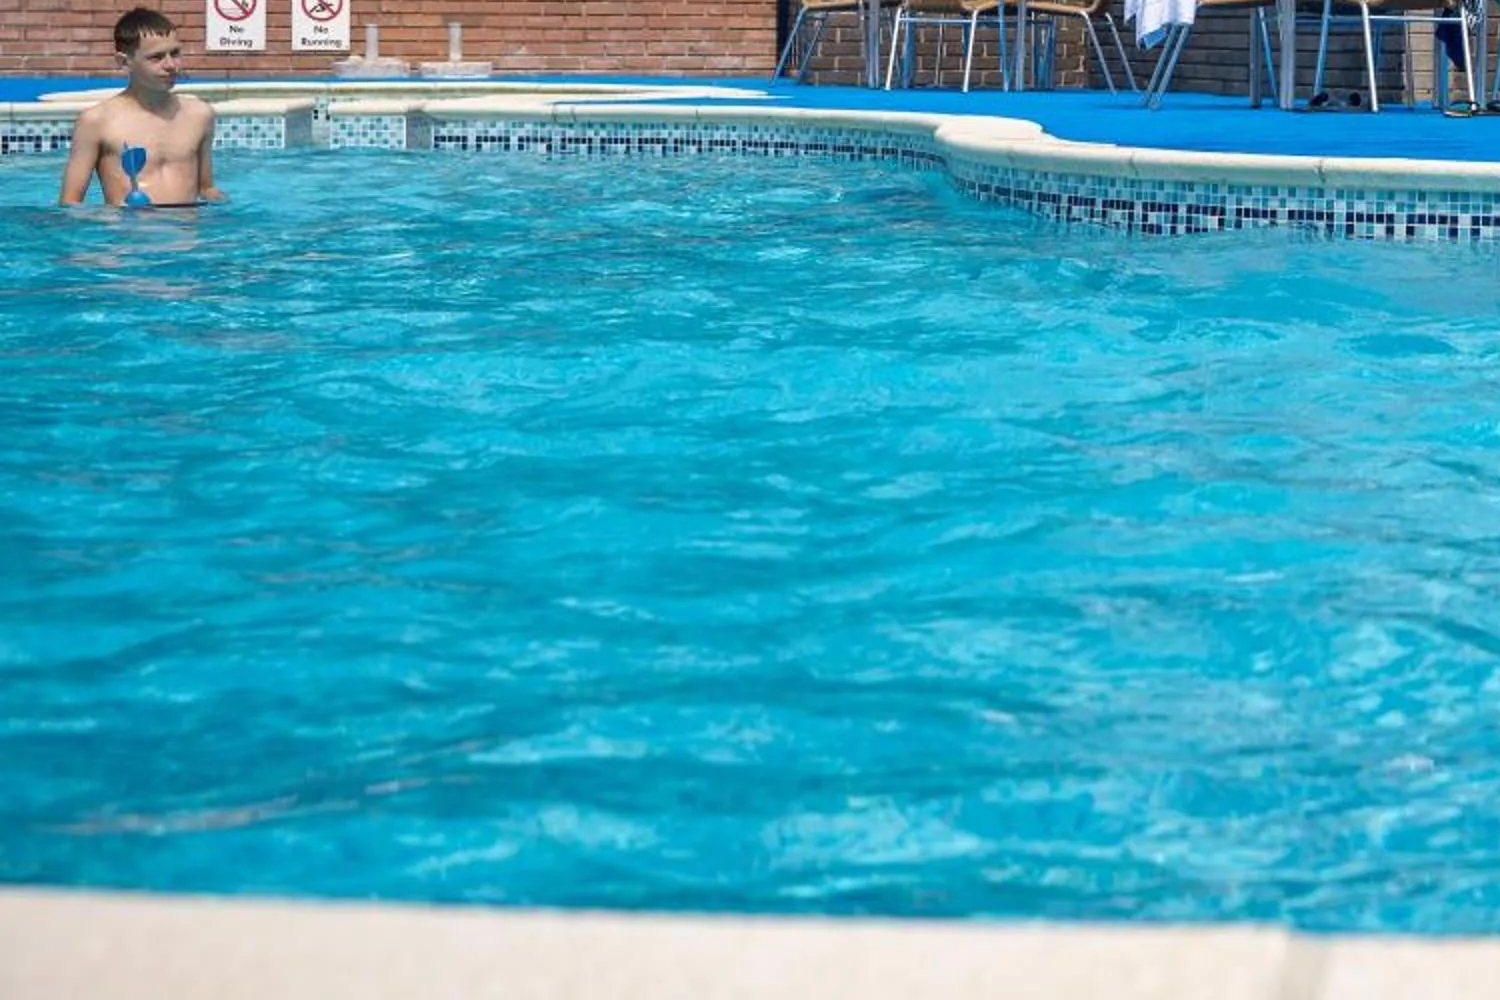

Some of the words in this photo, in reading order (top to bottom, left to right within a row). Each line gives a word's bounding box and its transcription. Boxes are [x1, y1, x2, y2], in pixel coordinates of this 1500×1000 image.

[229, 25, 244, 33] No
[314, 26, 329, 34] No
[220, 37, 253, 48] Diving
[301, 37, 343, 48] Running
